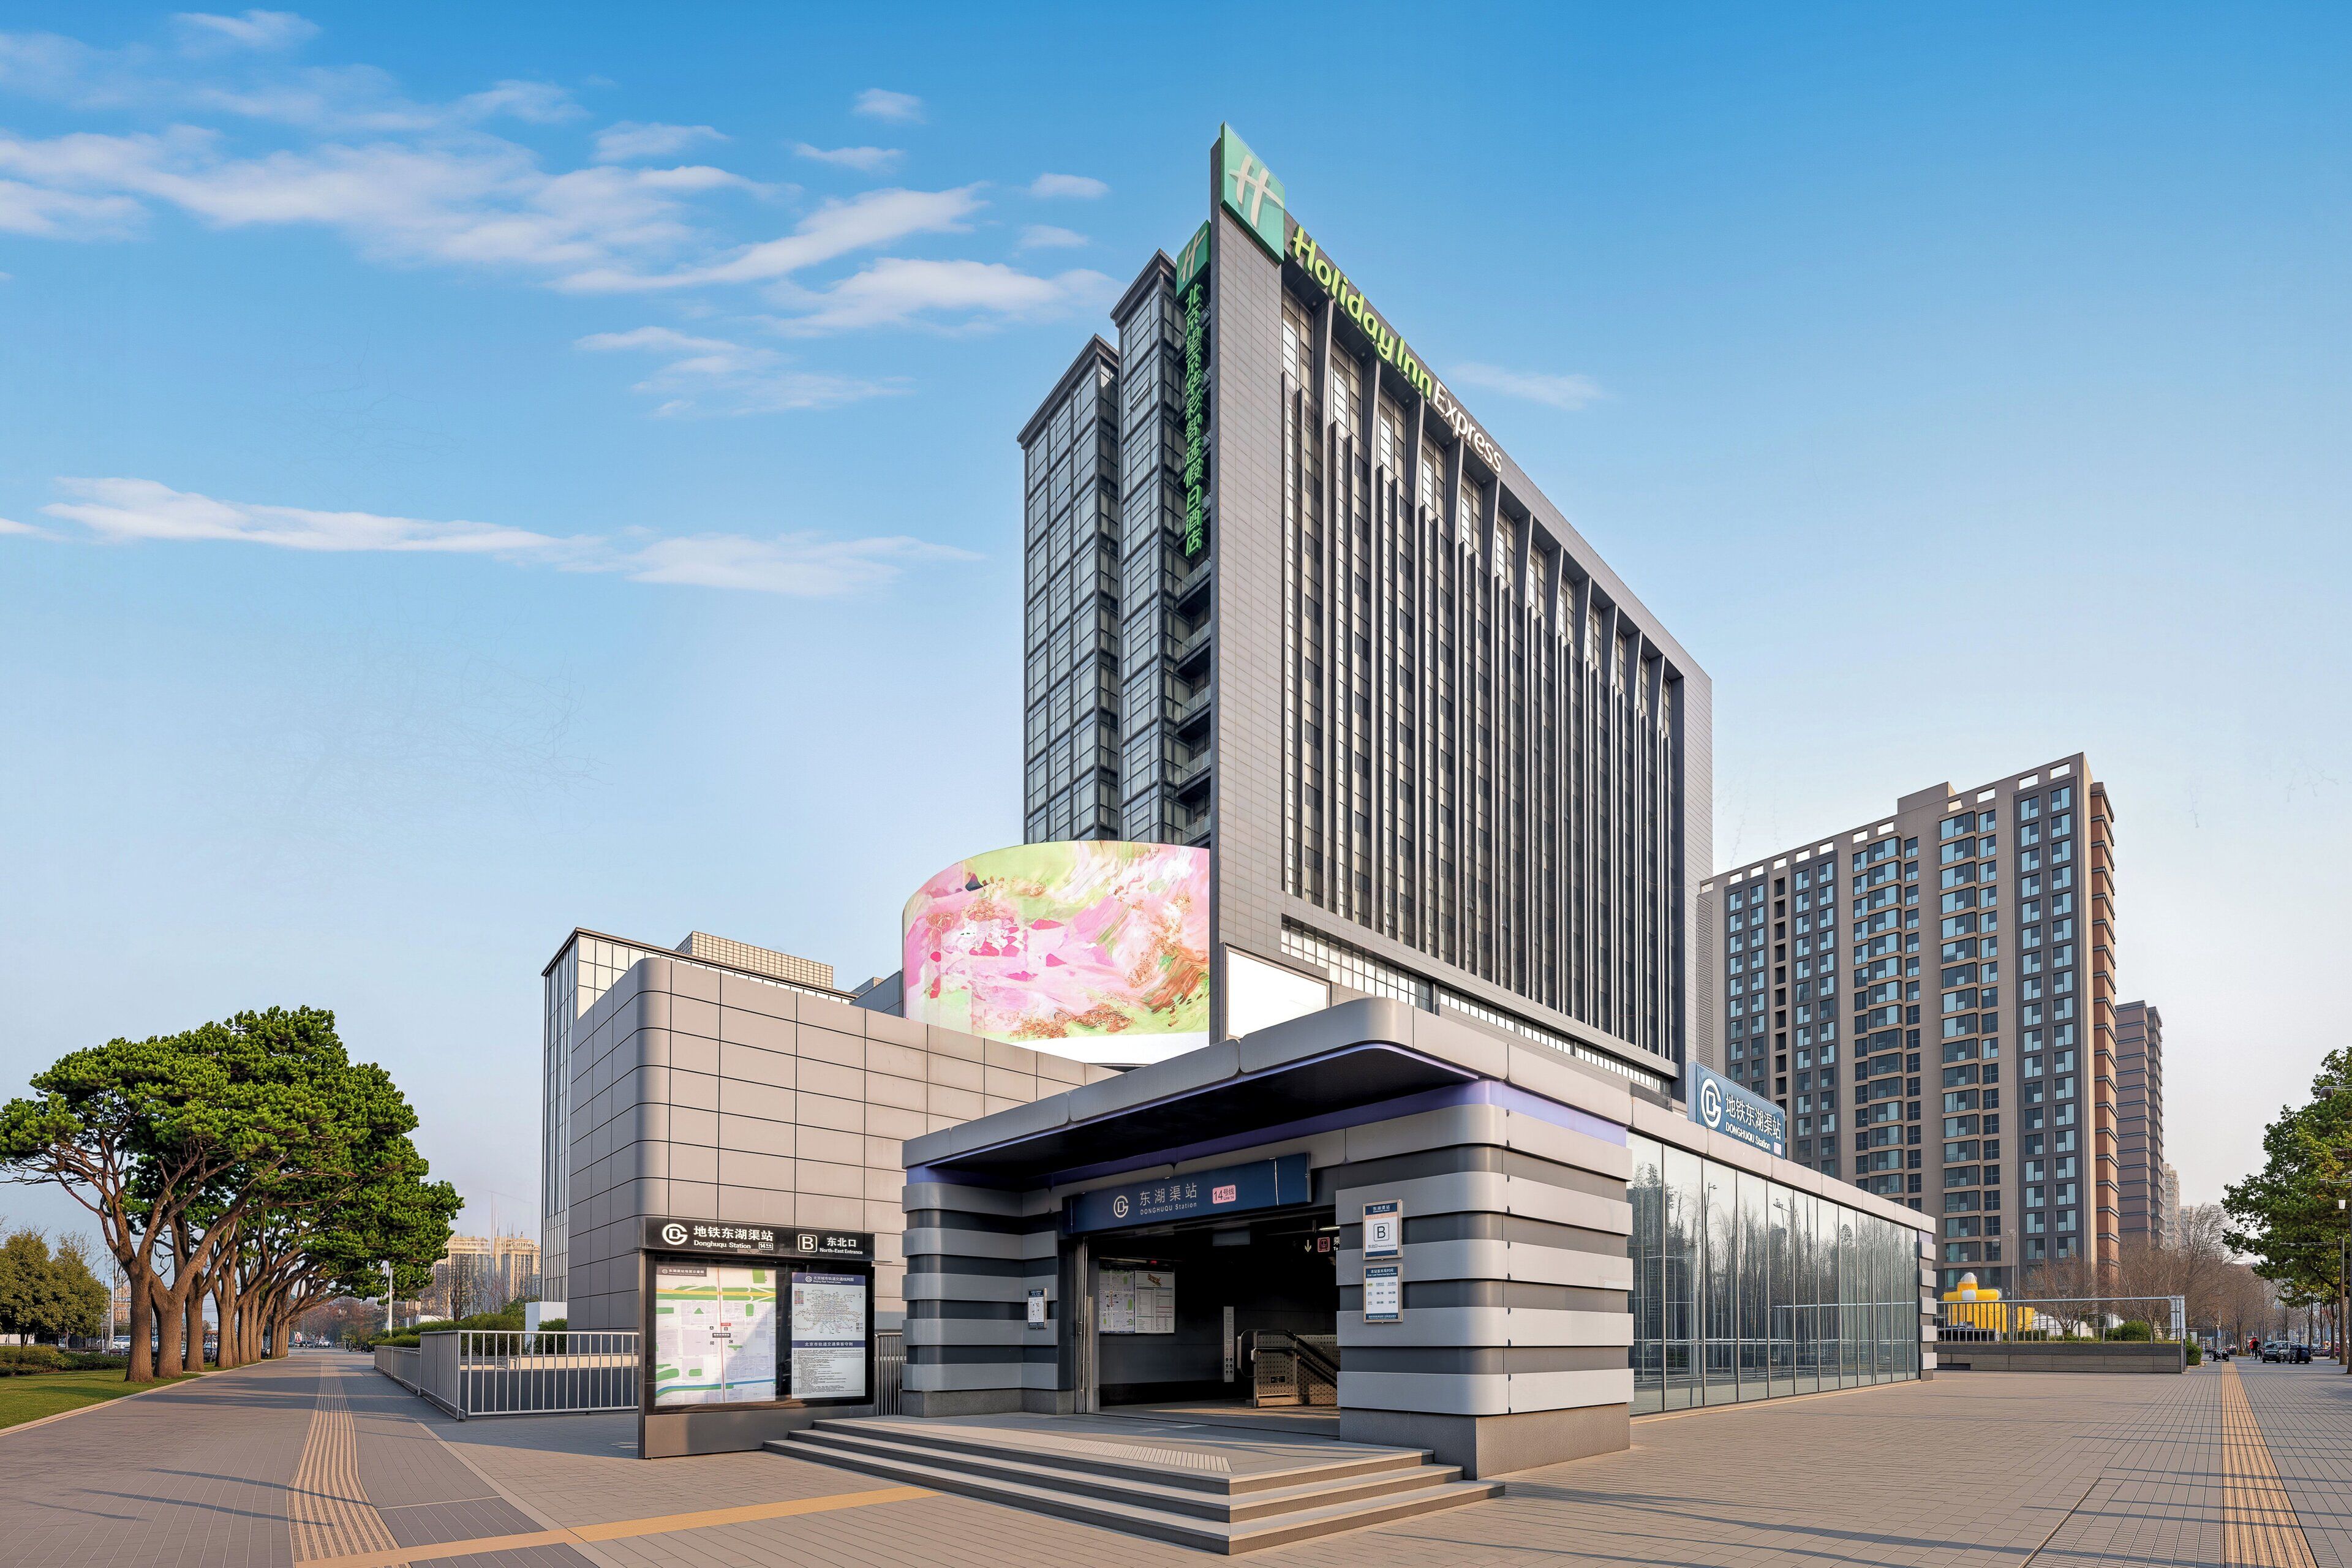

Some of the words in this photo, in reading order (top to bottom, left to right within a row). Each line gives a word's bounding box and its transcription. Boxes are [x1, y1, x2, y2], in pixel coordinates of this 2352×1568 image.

[1291, 224, 1396, 363] Holiday
[1395, 336, 1433, 401] Inn
[1434, 380, 1503, 473] Express
[1725, 1093, 1781, 1141] 地铁东湖渠站
[1725, 1121, 1755, 1144] DONGHUQU
[1755, 1136, 1771, 1151] Station
[1140, 1183, 1197, 1206] 东湖渠站
[1140, 1205, 1173, 1215] DONGHUQU
[1175, 1202, 1197, 1210] Station
[693, 1225, 774, 1242] 地铁东湖渠站
[1377, 1226, 1386, 1238] B
[802, 1236, 814, 1250] B
[827, 1237, 856, 1248] 东北口
